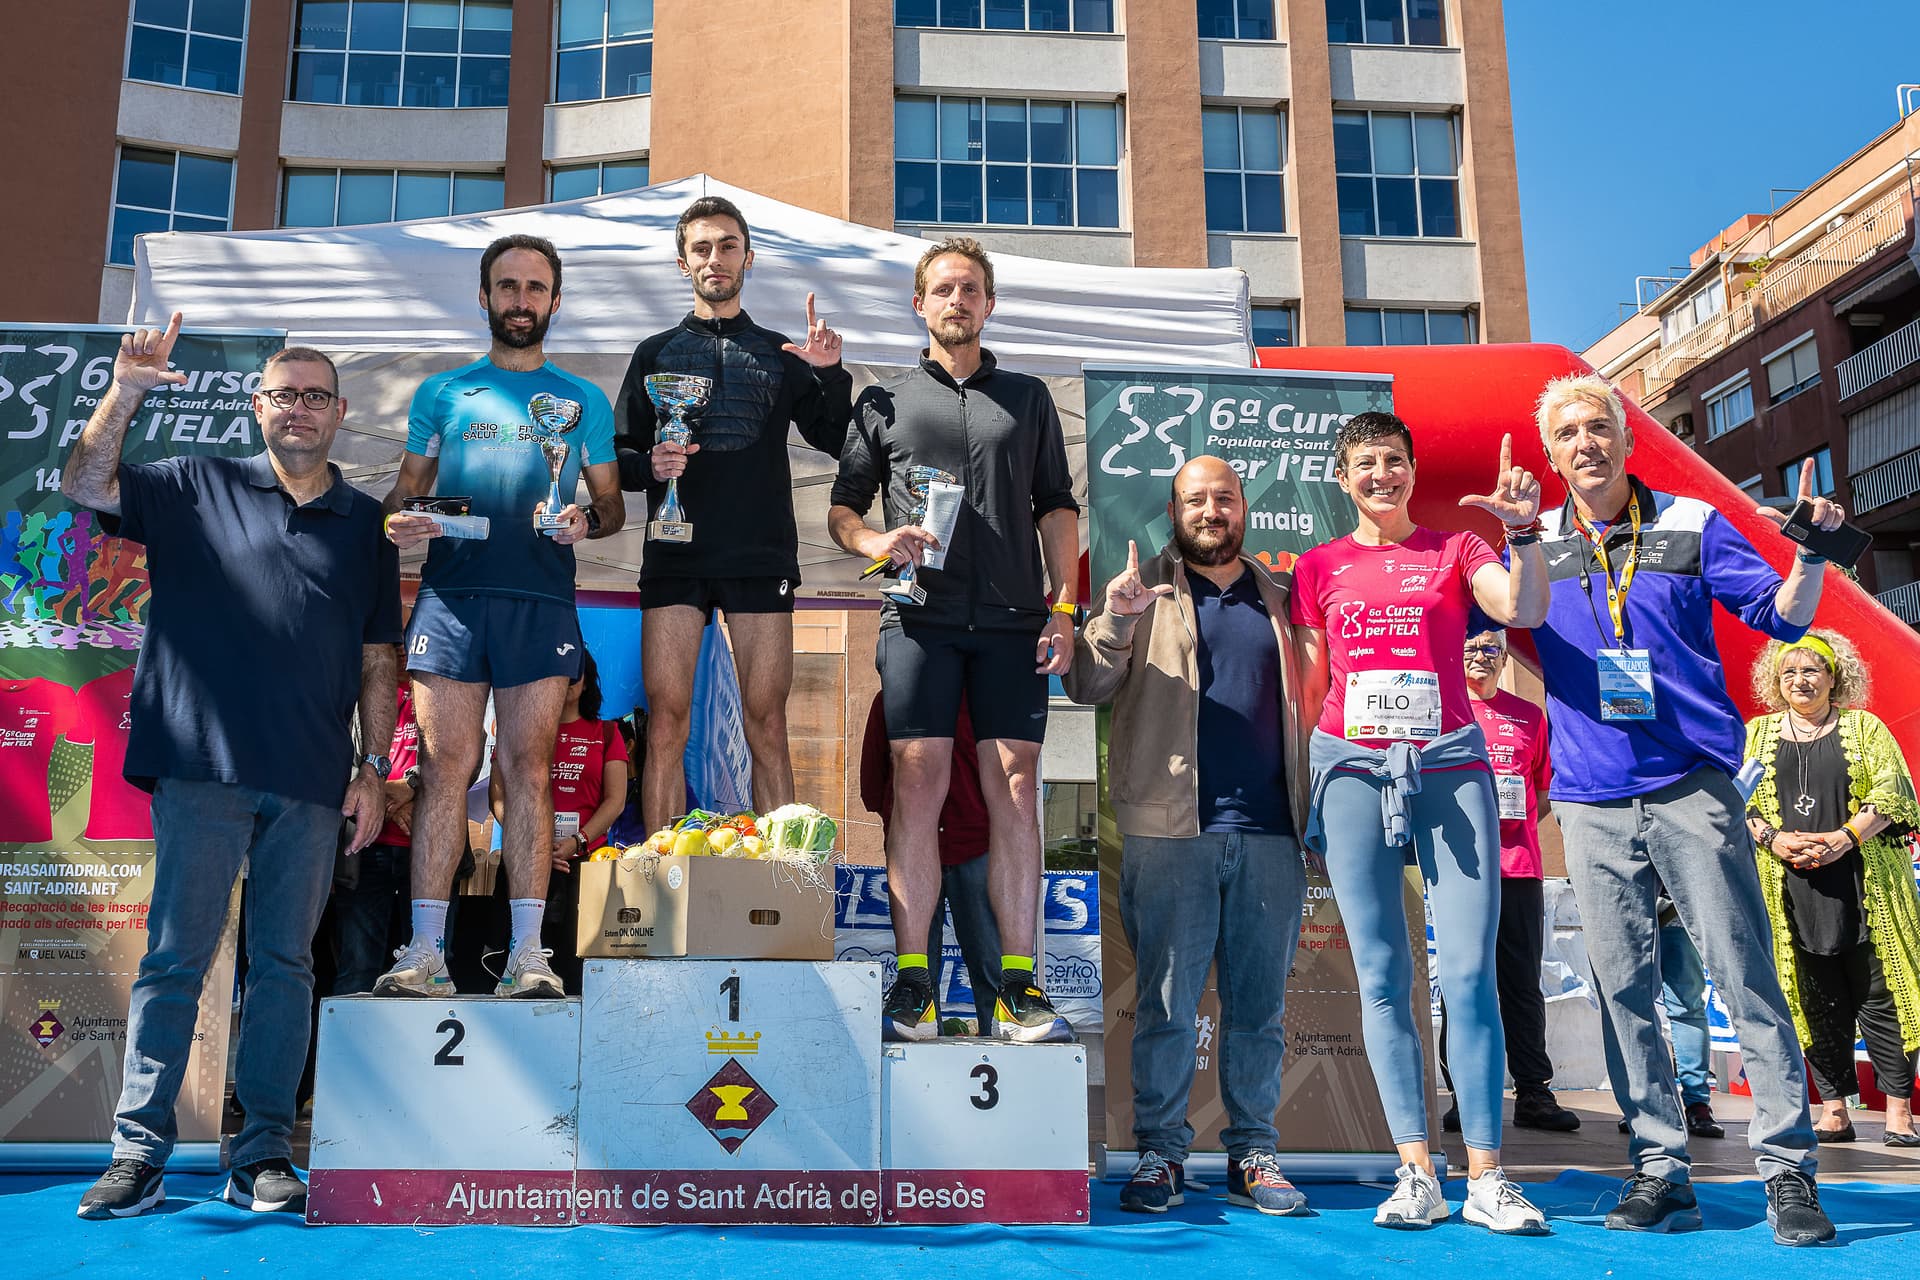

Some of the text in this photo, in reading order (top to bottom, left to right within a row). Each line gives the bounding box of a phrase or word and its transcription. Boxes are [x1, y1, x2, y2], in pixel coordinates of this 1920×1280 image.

[143, 396, 166, 408] de
[168, 396, 209, 411] Sant
[145, 412, 252, 445] l'ELA
[470, 423, 498, 431] FISIO
[518, 426, 534, 434] FIT
[463, 431, 498, 441] SALUT
[518, 433, 548, 444] SPOR
[1206, 435, 1270, 450] Popular
[1271, 437, 1292, 450] de
[1293, 438, 1331, 451] Sant
[1228, 457, 1268, 480] er
[1250, 506, 1314, 536] maig
[1385, 604, 1424, 617] Cursa
[1365, 623, 1420, 639] per l'ELA
[1366, 694, 1410, 710] FILO
[1492, 743, 1515, 752] Cursa
[558, 761, 585, 770] Cursa
[558, 772, 580, 781] l'ELA
[3, 881, 119, 896] SANT-ADRIA.NET
[0, 901, 67, 915] Recaptació
[70, 901, 84, 913] de
[87, 901, 105, 913] les
[34, 919, 52, 930] als
[55, 919, 103, 930] afectats
[106, 920, 127, 932] per
[630, 927, 655, 937] ONLINE
[1309, 940, 1328, 952] per
[18, 949, 87, 960] MIQUEL VALLS
[719, 975, 742, 1023] 1
[71, 1030, 86, 1042] de
[88, 1030, 116, 1042] Sant
[433, 1018, 466, 1067] 2
[1294, 1031, 1353, 1045] Ajuntament
[1295, 1045, 1364, 1057] de Sant Adrià
[968, 1063, 1000, 1111] 3
[445, 1181, 986, 1216] Ajuntament de Sant Adrià de Besòs
